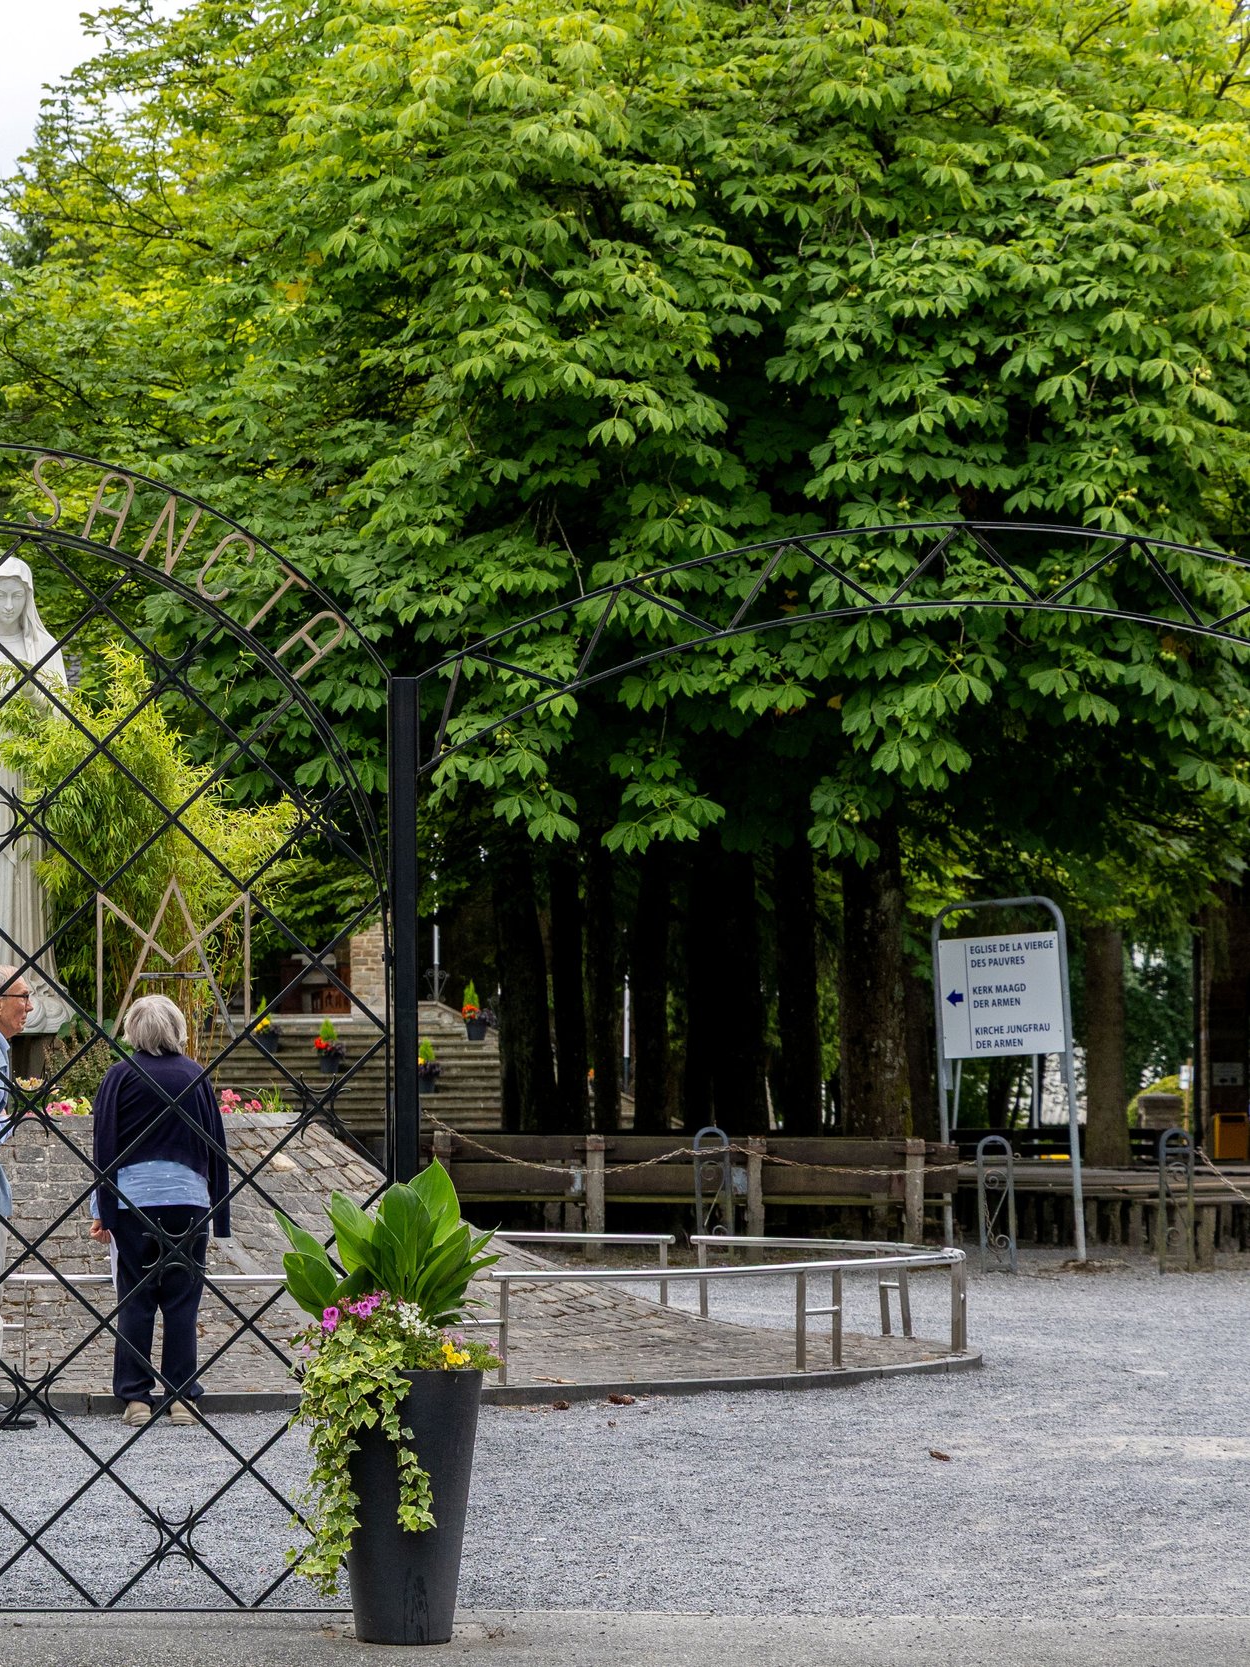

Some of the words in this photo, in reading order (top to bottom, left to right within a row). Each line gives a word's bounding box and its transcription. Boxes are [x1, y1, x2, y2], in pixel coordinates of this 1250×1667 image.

[26, 455, 347, 681] SANCTA
[970, 943, 997, 954] EGLISE
[999, 943, 1011, 952] DE
[1012, 942, 1023, 951] LA
[1024, 940, 1054, 950] VIERGE
[971, 959, 986, 968] DES
[988, 956, 1025, 967] PAUVRES
[972, 986, 993, 995] KERK
[995, 983, 1026, 993] MAAGD
[973, 999, 990, 1009] DER
[991, 998, 1021, 1007] ARMEN
[975, 1026, 1004, 1036] KIRCHE
[1006, 1023, 1050, 1034] JUNGFRAU
[976, 1040, 992, 1050] DER
[994, 1038, 1023, 1048] ARMEN
